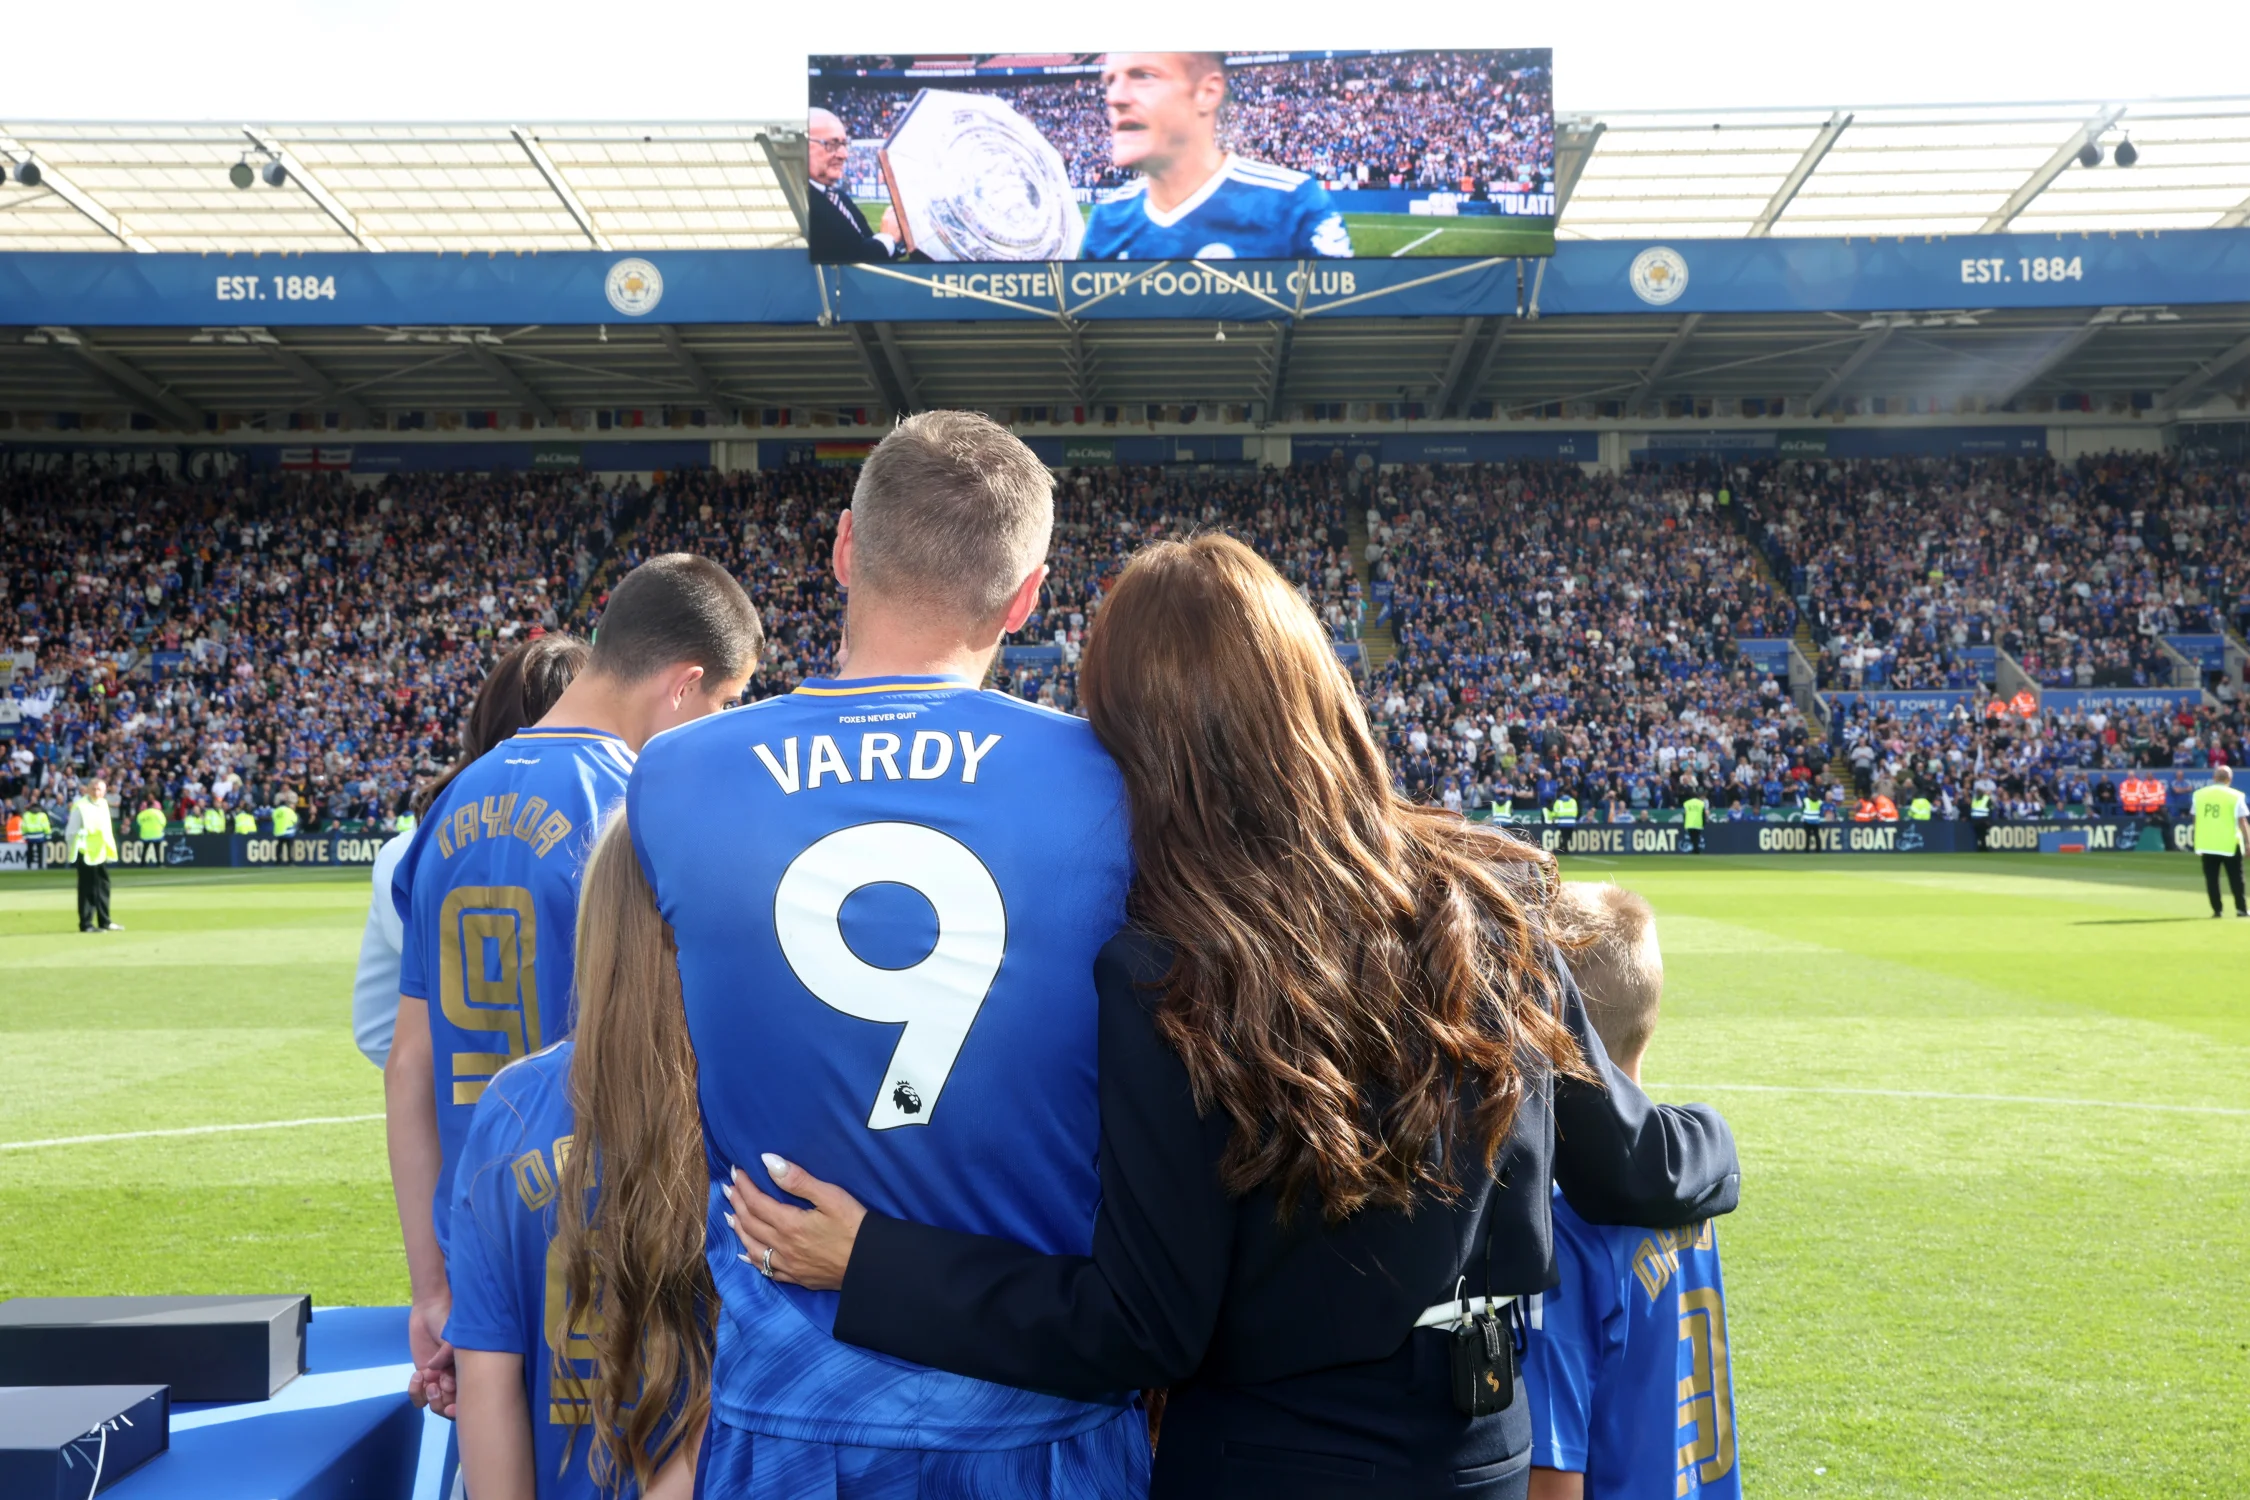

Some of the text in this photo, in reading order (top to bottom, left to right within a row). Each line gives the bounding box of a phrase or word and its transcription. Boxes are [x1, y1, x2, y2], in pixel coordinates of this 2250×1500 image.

[1961, 256, 2083, 284] EST. 1884
[216, 275, 336, 300] EST. 1884
[1071, 272, 1132, 296] CITY
[1141, 271, 1278, 296] FOOTBALL
[1286, 271, 1356, 295] CLUB
[1899, 699, 1947, 710] POWER
[839, 711, 917, 724] FOXES NEVER QUIT
[750, 730, 1004, 795] VARDY
[2203, 803, 2220, 818] P8
[435, 792, 572, 860] TAYLOR
[1759, 827, 1842, 850] GOODYE
[1850, 826, 1897, 850] GOAT
[337, 839, 384, 863] GOAT
[1632, 828, 1679, 851] GOAT
[773, 820, 1008, 1131] 9
[439, 885, 542, 1105] 9
